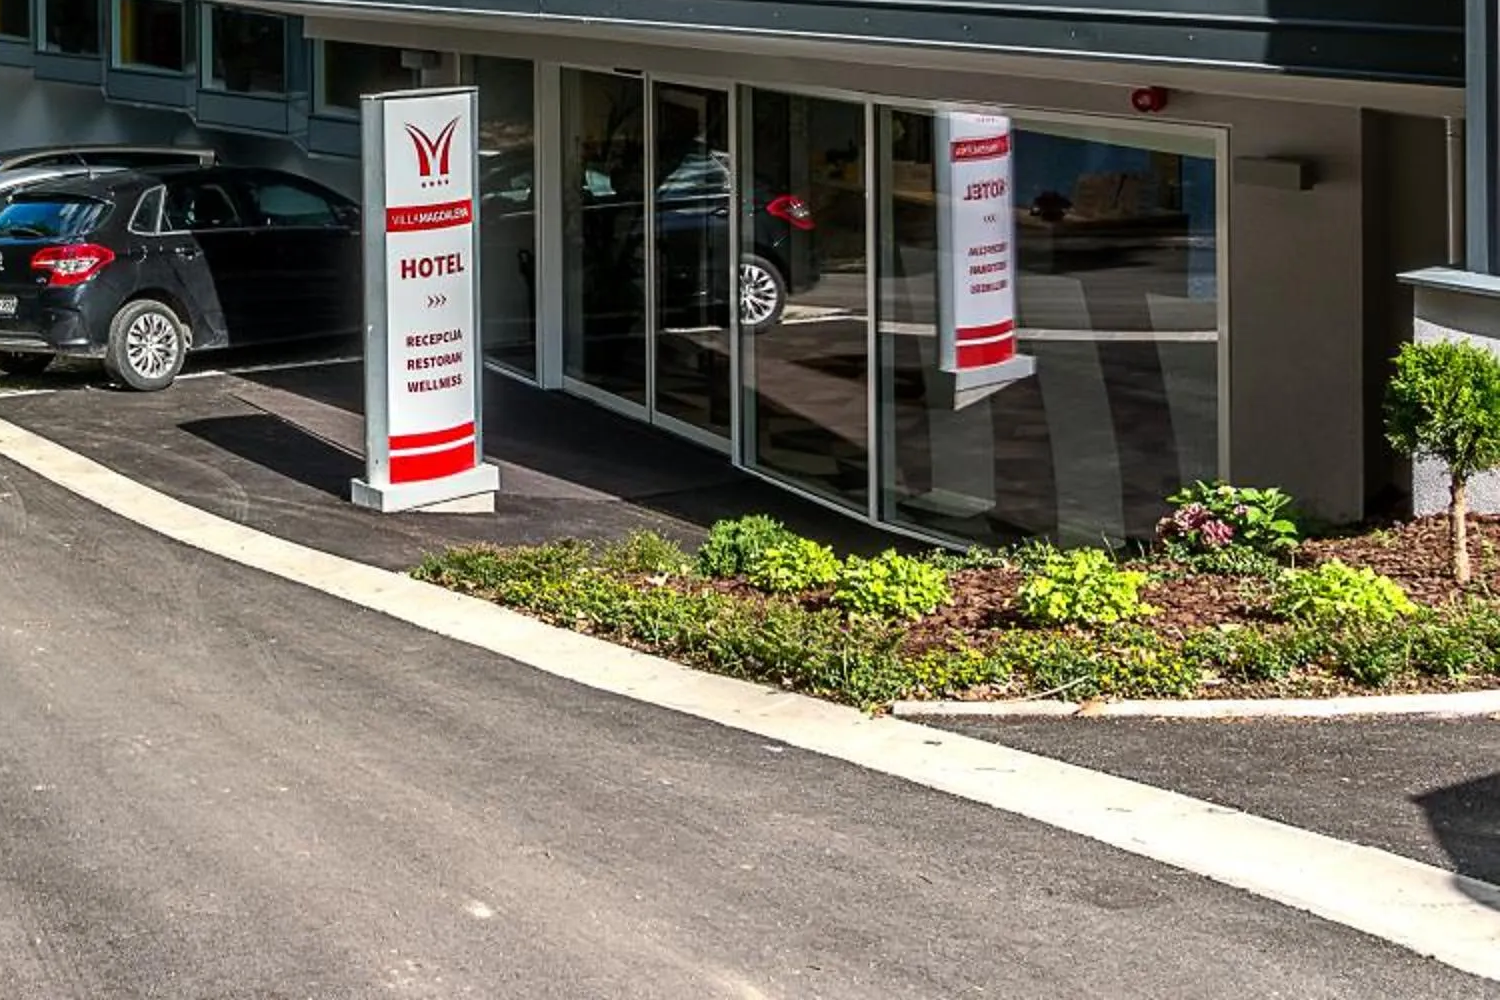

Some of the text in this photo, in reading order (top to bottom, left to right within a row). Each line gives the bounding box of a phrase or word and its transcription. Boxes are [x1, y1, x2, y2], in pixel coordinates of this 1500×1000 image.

[400, 251, 465, 280] HOTEL
[406, 328, 463, 347] RECEPCIJA
[407, 351, 463, 371] RESTORAN
[407, 373, 463, 393] WELLNESS
